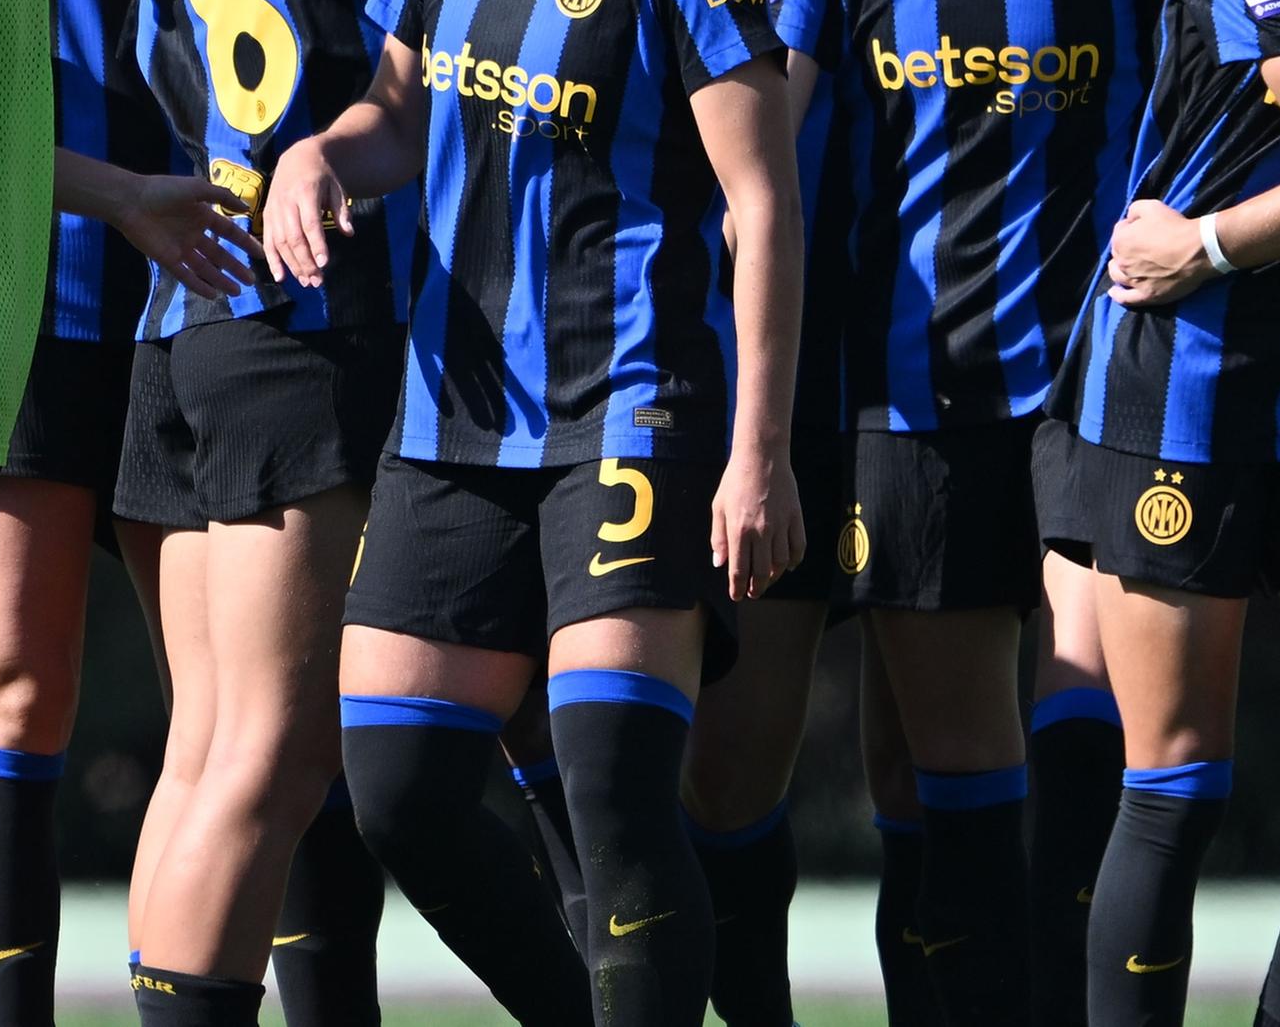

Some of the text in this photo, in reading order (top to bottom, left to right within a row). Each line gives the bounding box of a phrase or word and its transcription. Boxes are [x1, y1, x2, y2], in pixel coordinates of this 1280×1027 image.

[421, 32, 598, 124] betsson
[871, 35, 1100, 92] betsson
[985, 81, 1093, 118] .sport
[597, 456, 654, 543] 5
